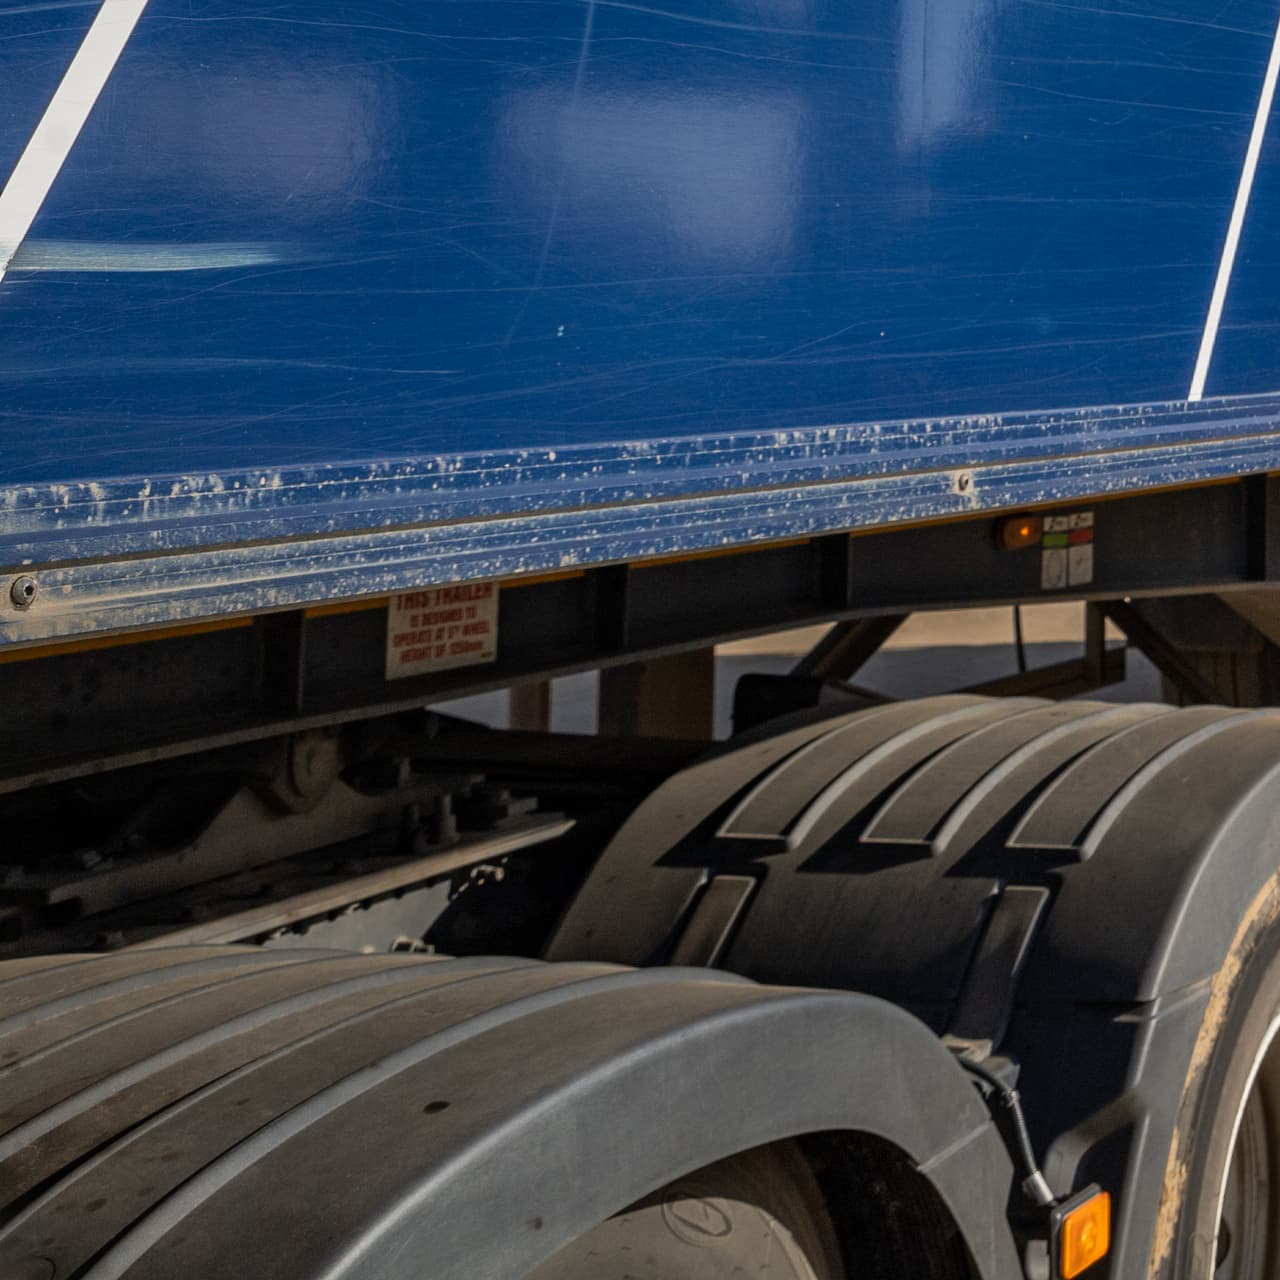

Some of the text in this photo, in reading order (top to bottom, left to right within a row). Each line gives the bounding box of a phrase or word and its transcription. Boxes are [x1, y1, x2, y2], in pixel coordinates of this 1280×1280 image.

[396, 581, 494, 611] THIS TRAILER
[421, 607, 463, 626] DESIGNED
[393, 629, 432, 648] OPERATE
[462, 620, 490, 636] WHEEL
[400, 645, 432, 663] HEIGHT
